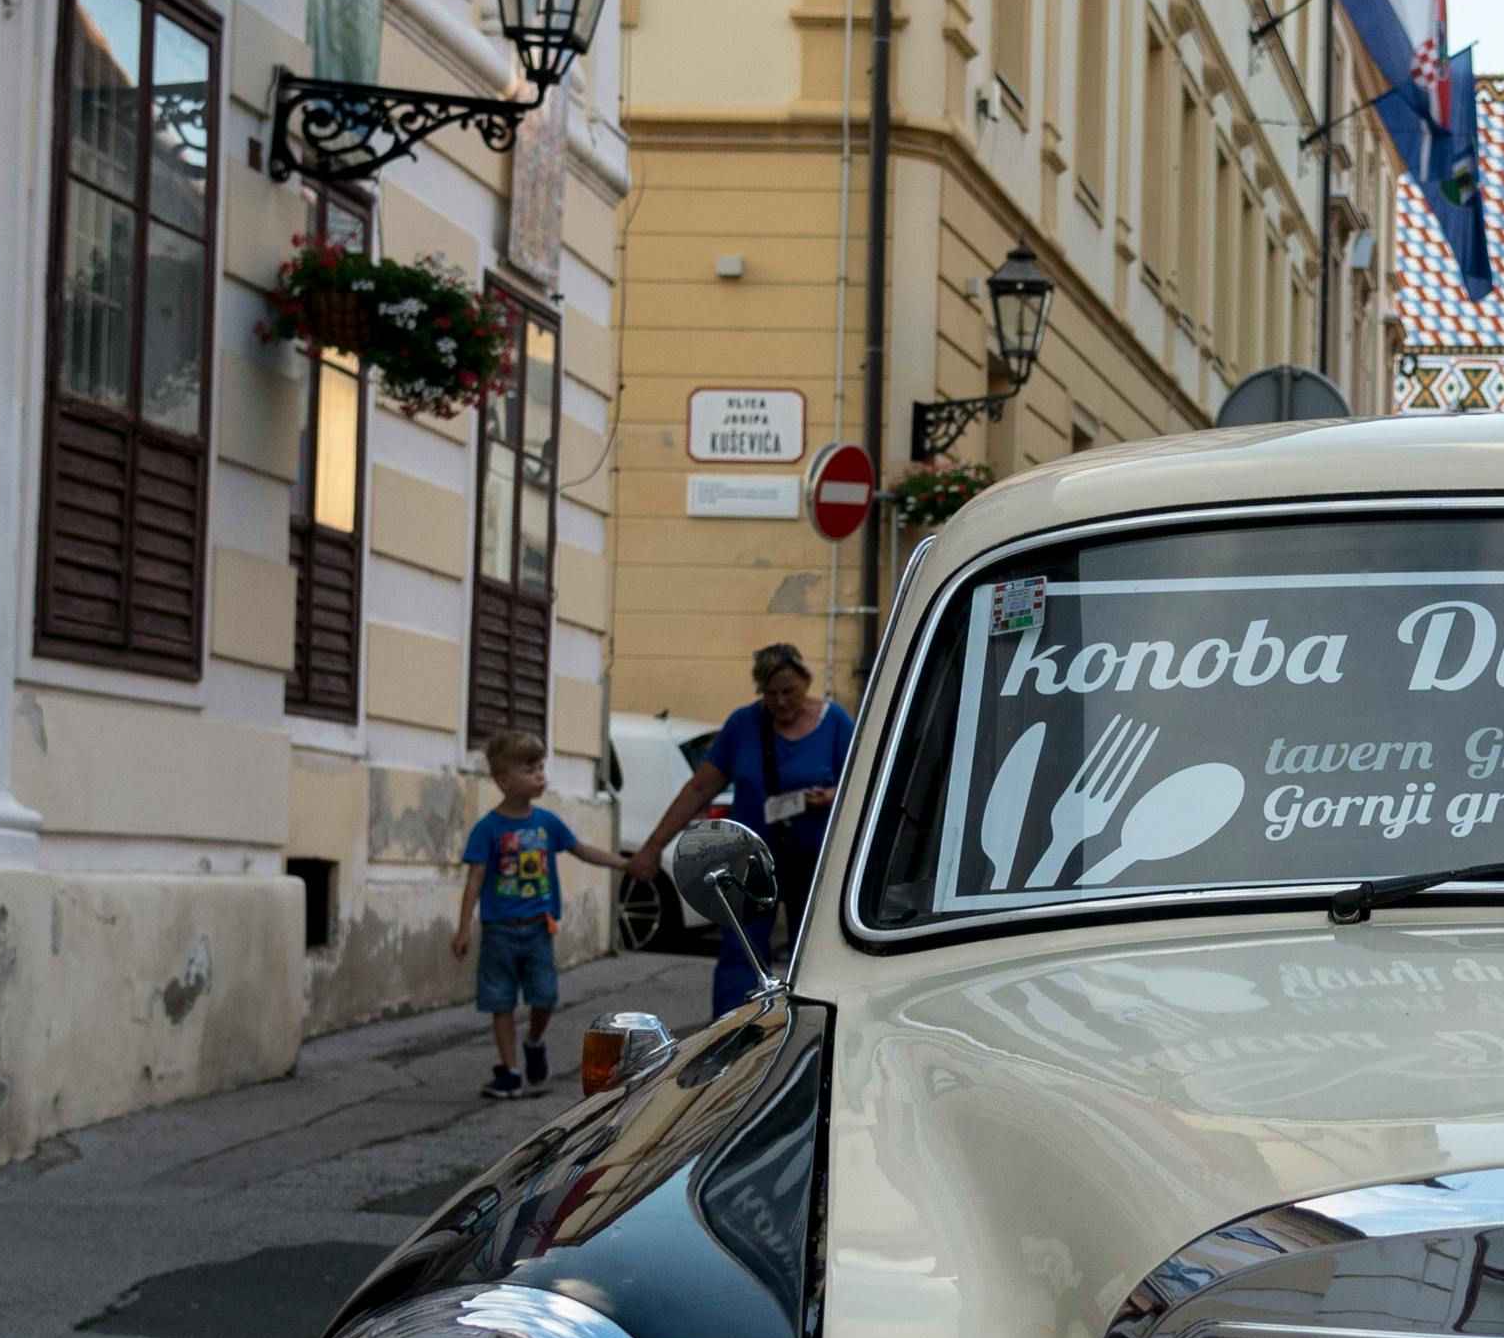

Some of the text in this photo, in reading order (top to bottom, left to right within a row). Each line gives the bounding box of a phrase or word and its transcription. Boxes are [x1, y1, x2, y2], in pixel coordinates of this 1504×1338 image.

[727, 396, 767, 410] ULICA
[722, 413, 768, 427] JOSIPA
[710, 429, 782, 455] KUŠEVIĆA
[999, 619, 1348, 697] konoba
[1265, 737, 1434, 776] tavern
[1262, 781, 1436, 842] Gornji
